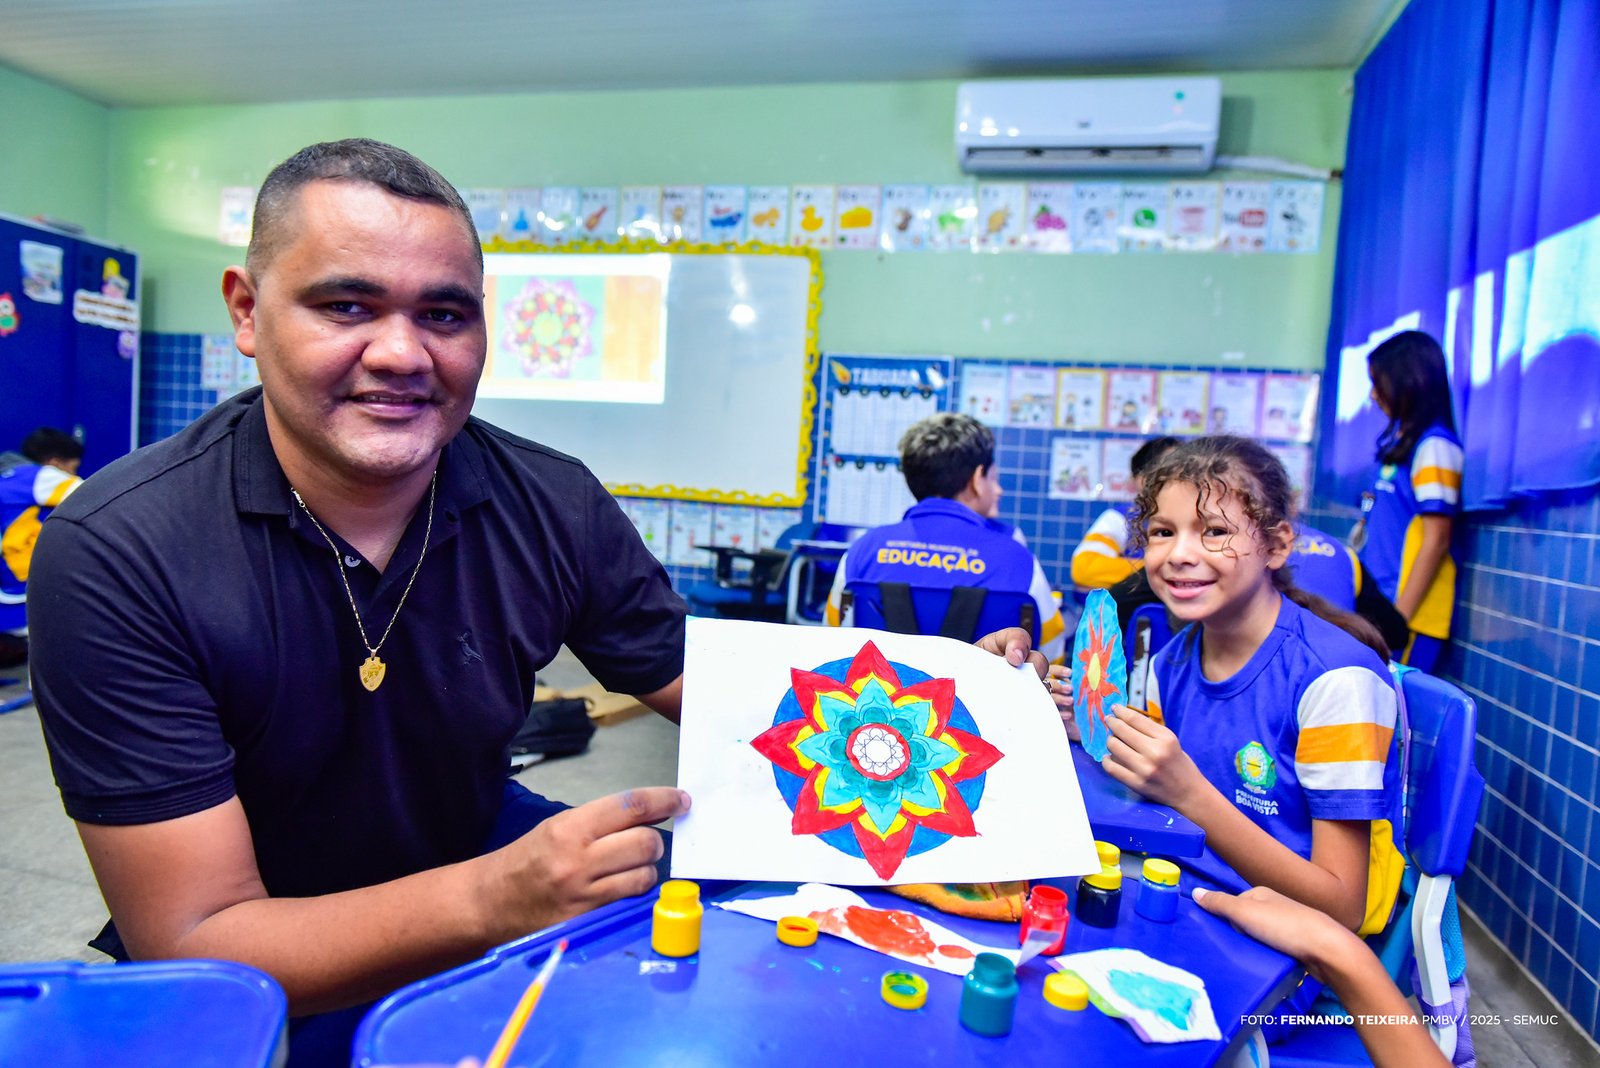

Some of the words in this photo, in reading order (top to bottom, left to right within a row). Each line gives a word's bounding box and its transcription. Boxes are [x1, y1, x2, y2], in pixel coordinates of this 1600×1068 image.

[877, 547, 986, 575] EDUCAÇÃO
[1236, 789, 1278, 806] PREFEITURA
[1236, 795, 1253, 808] BOA
[1252, 803, 1278, 815] VISTA
